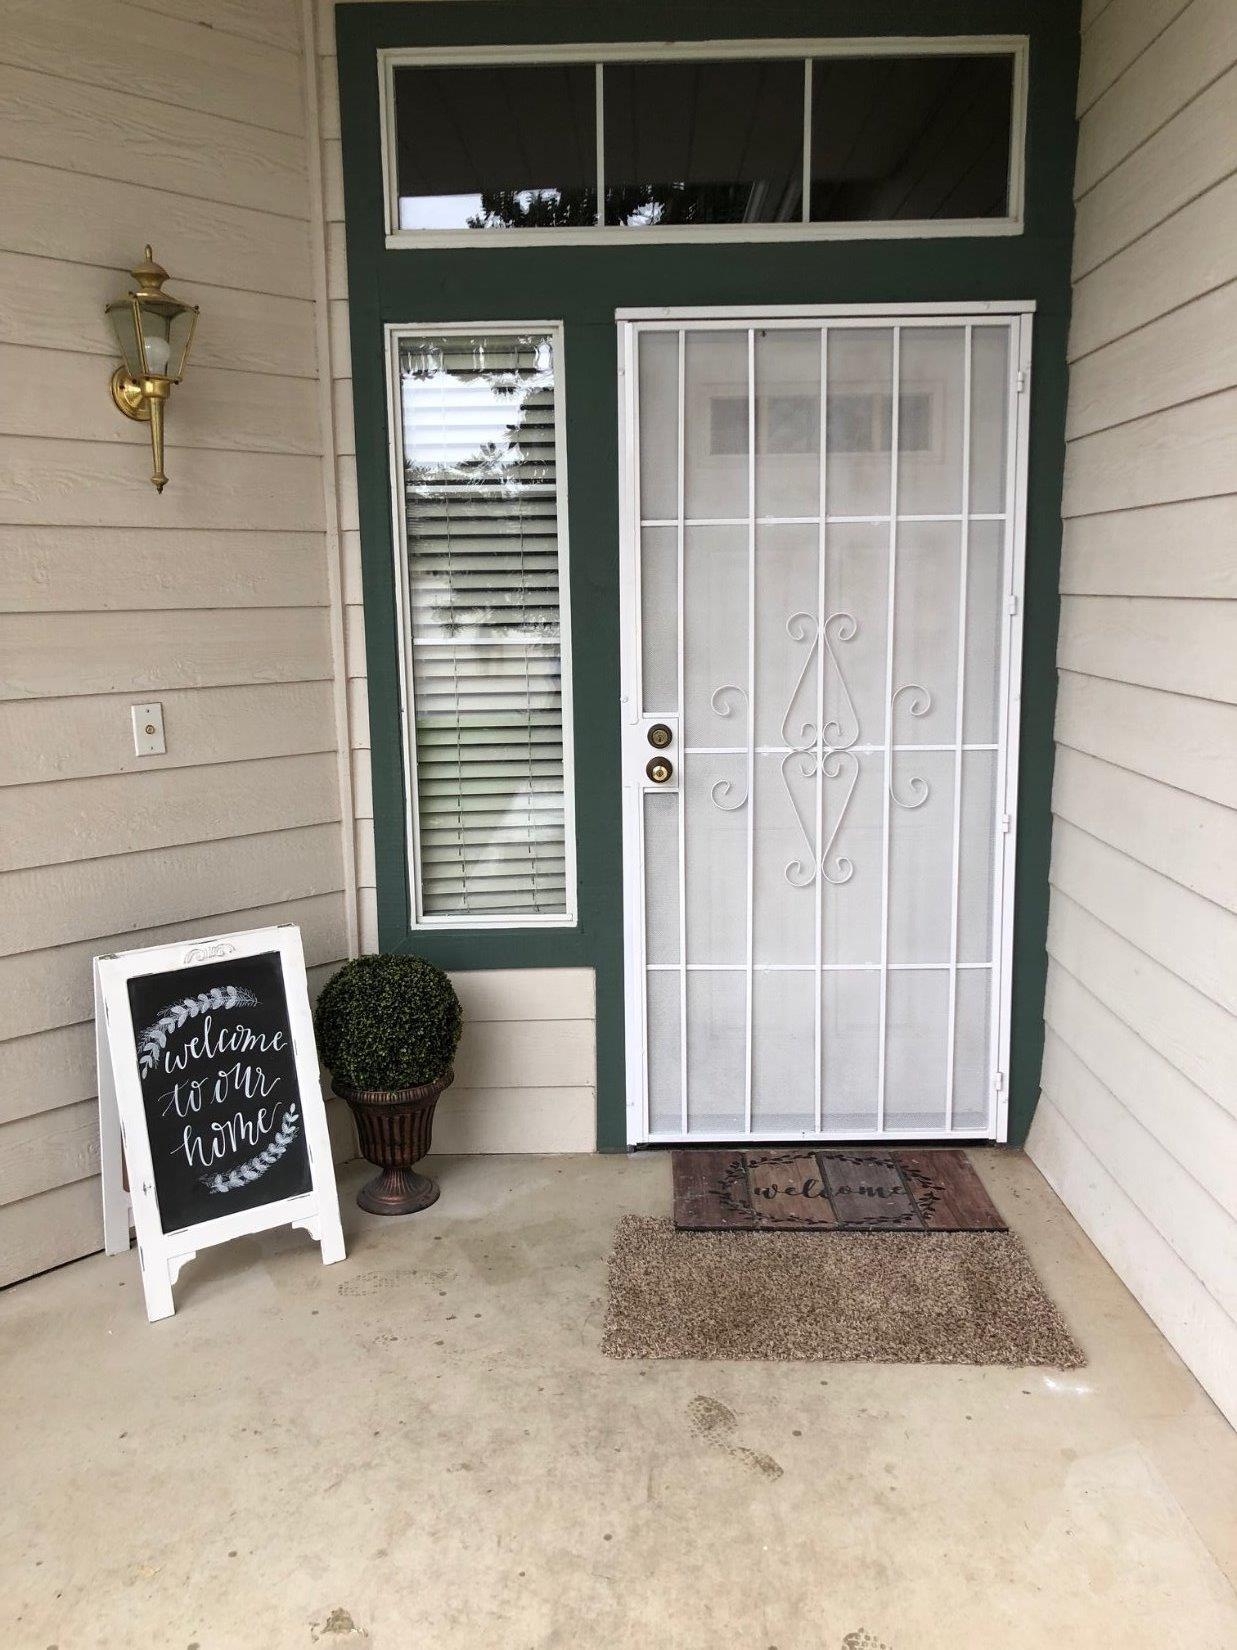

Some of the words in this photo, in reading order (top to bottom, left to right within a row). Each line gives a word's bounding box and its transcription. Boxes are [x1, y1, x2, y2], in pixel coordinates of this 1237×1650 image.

[164, 1015, 288, 1074] welcome
[158, 1077, 209, 1118] to
[211, 1061, 281, 1103] our
[170, 1102, 282, 1167] home
[754, 1178, 907, 1199] welcome
